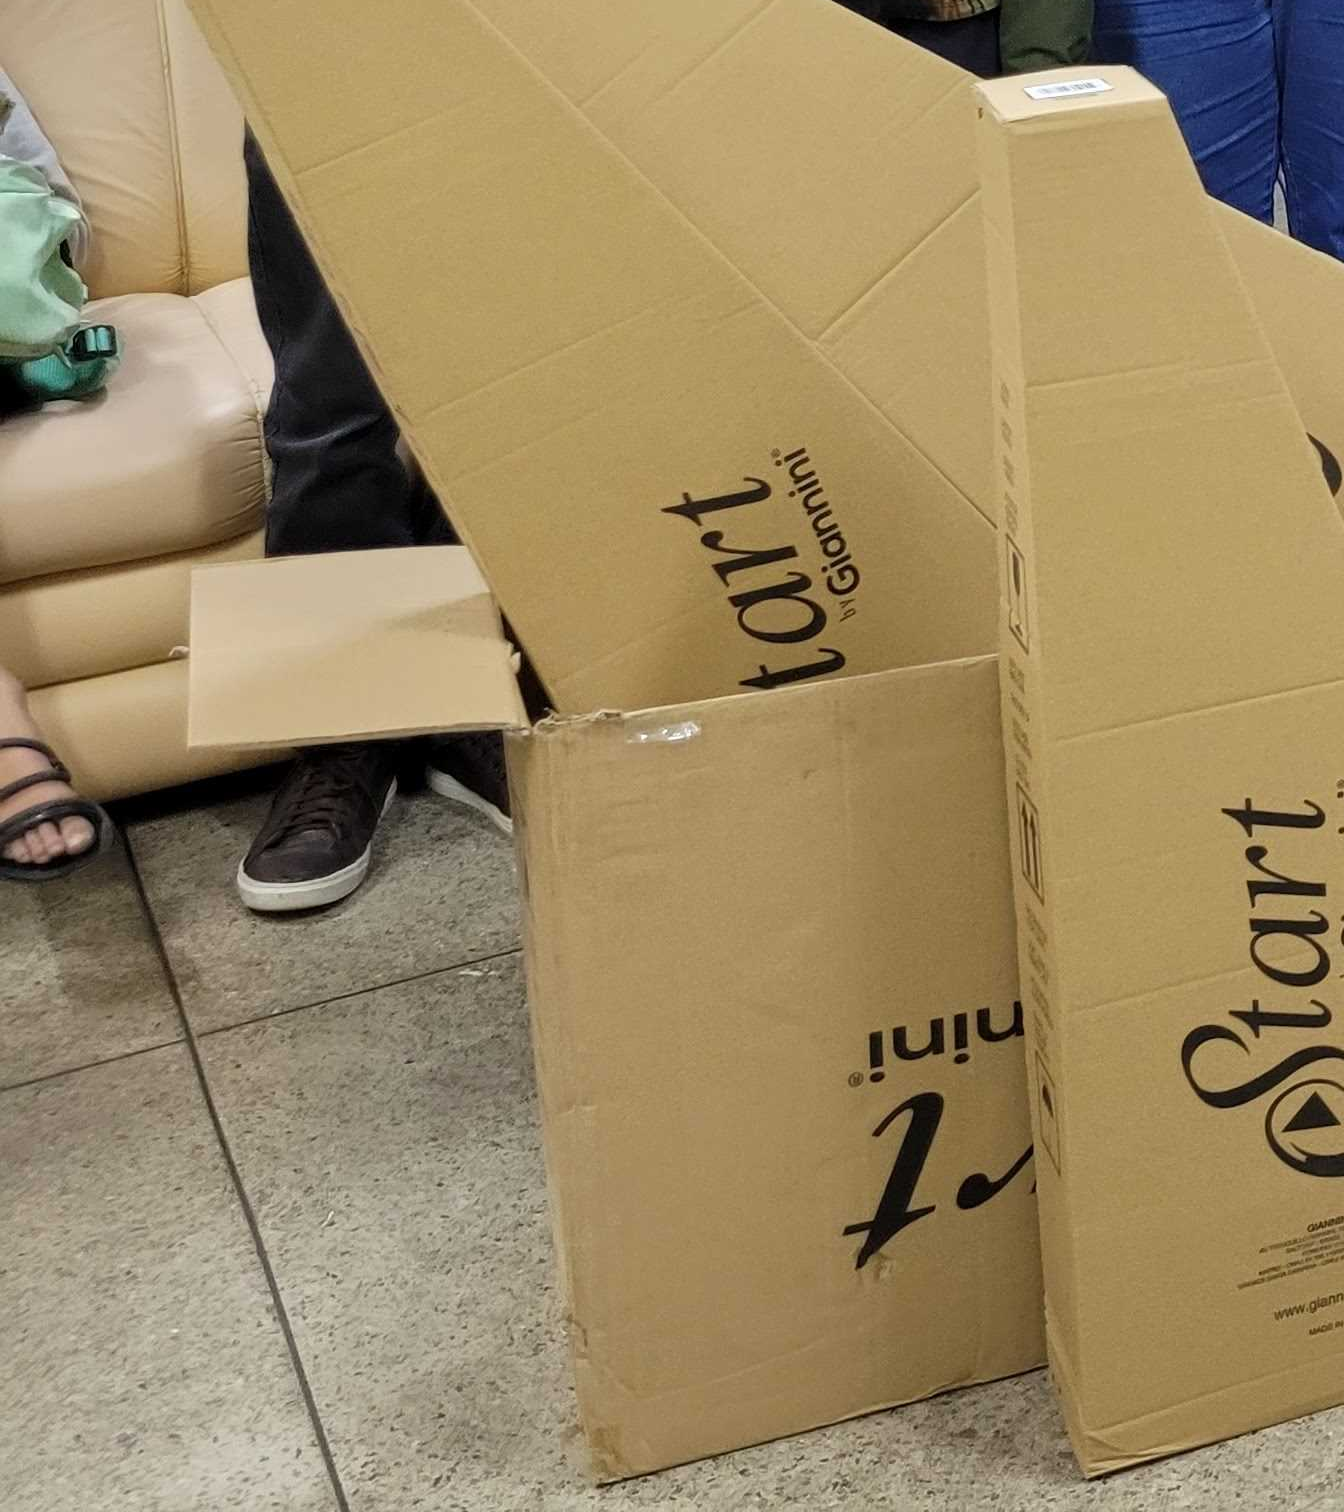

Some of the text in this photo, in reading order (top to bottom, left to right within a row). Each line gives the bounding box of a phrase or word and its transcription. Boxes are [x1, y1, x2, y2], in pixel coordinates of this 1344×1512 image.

[661, 476, 846, 689] tart
[839, 597, 857, 623] by
[866, 1000, 1025, 1083] nini
